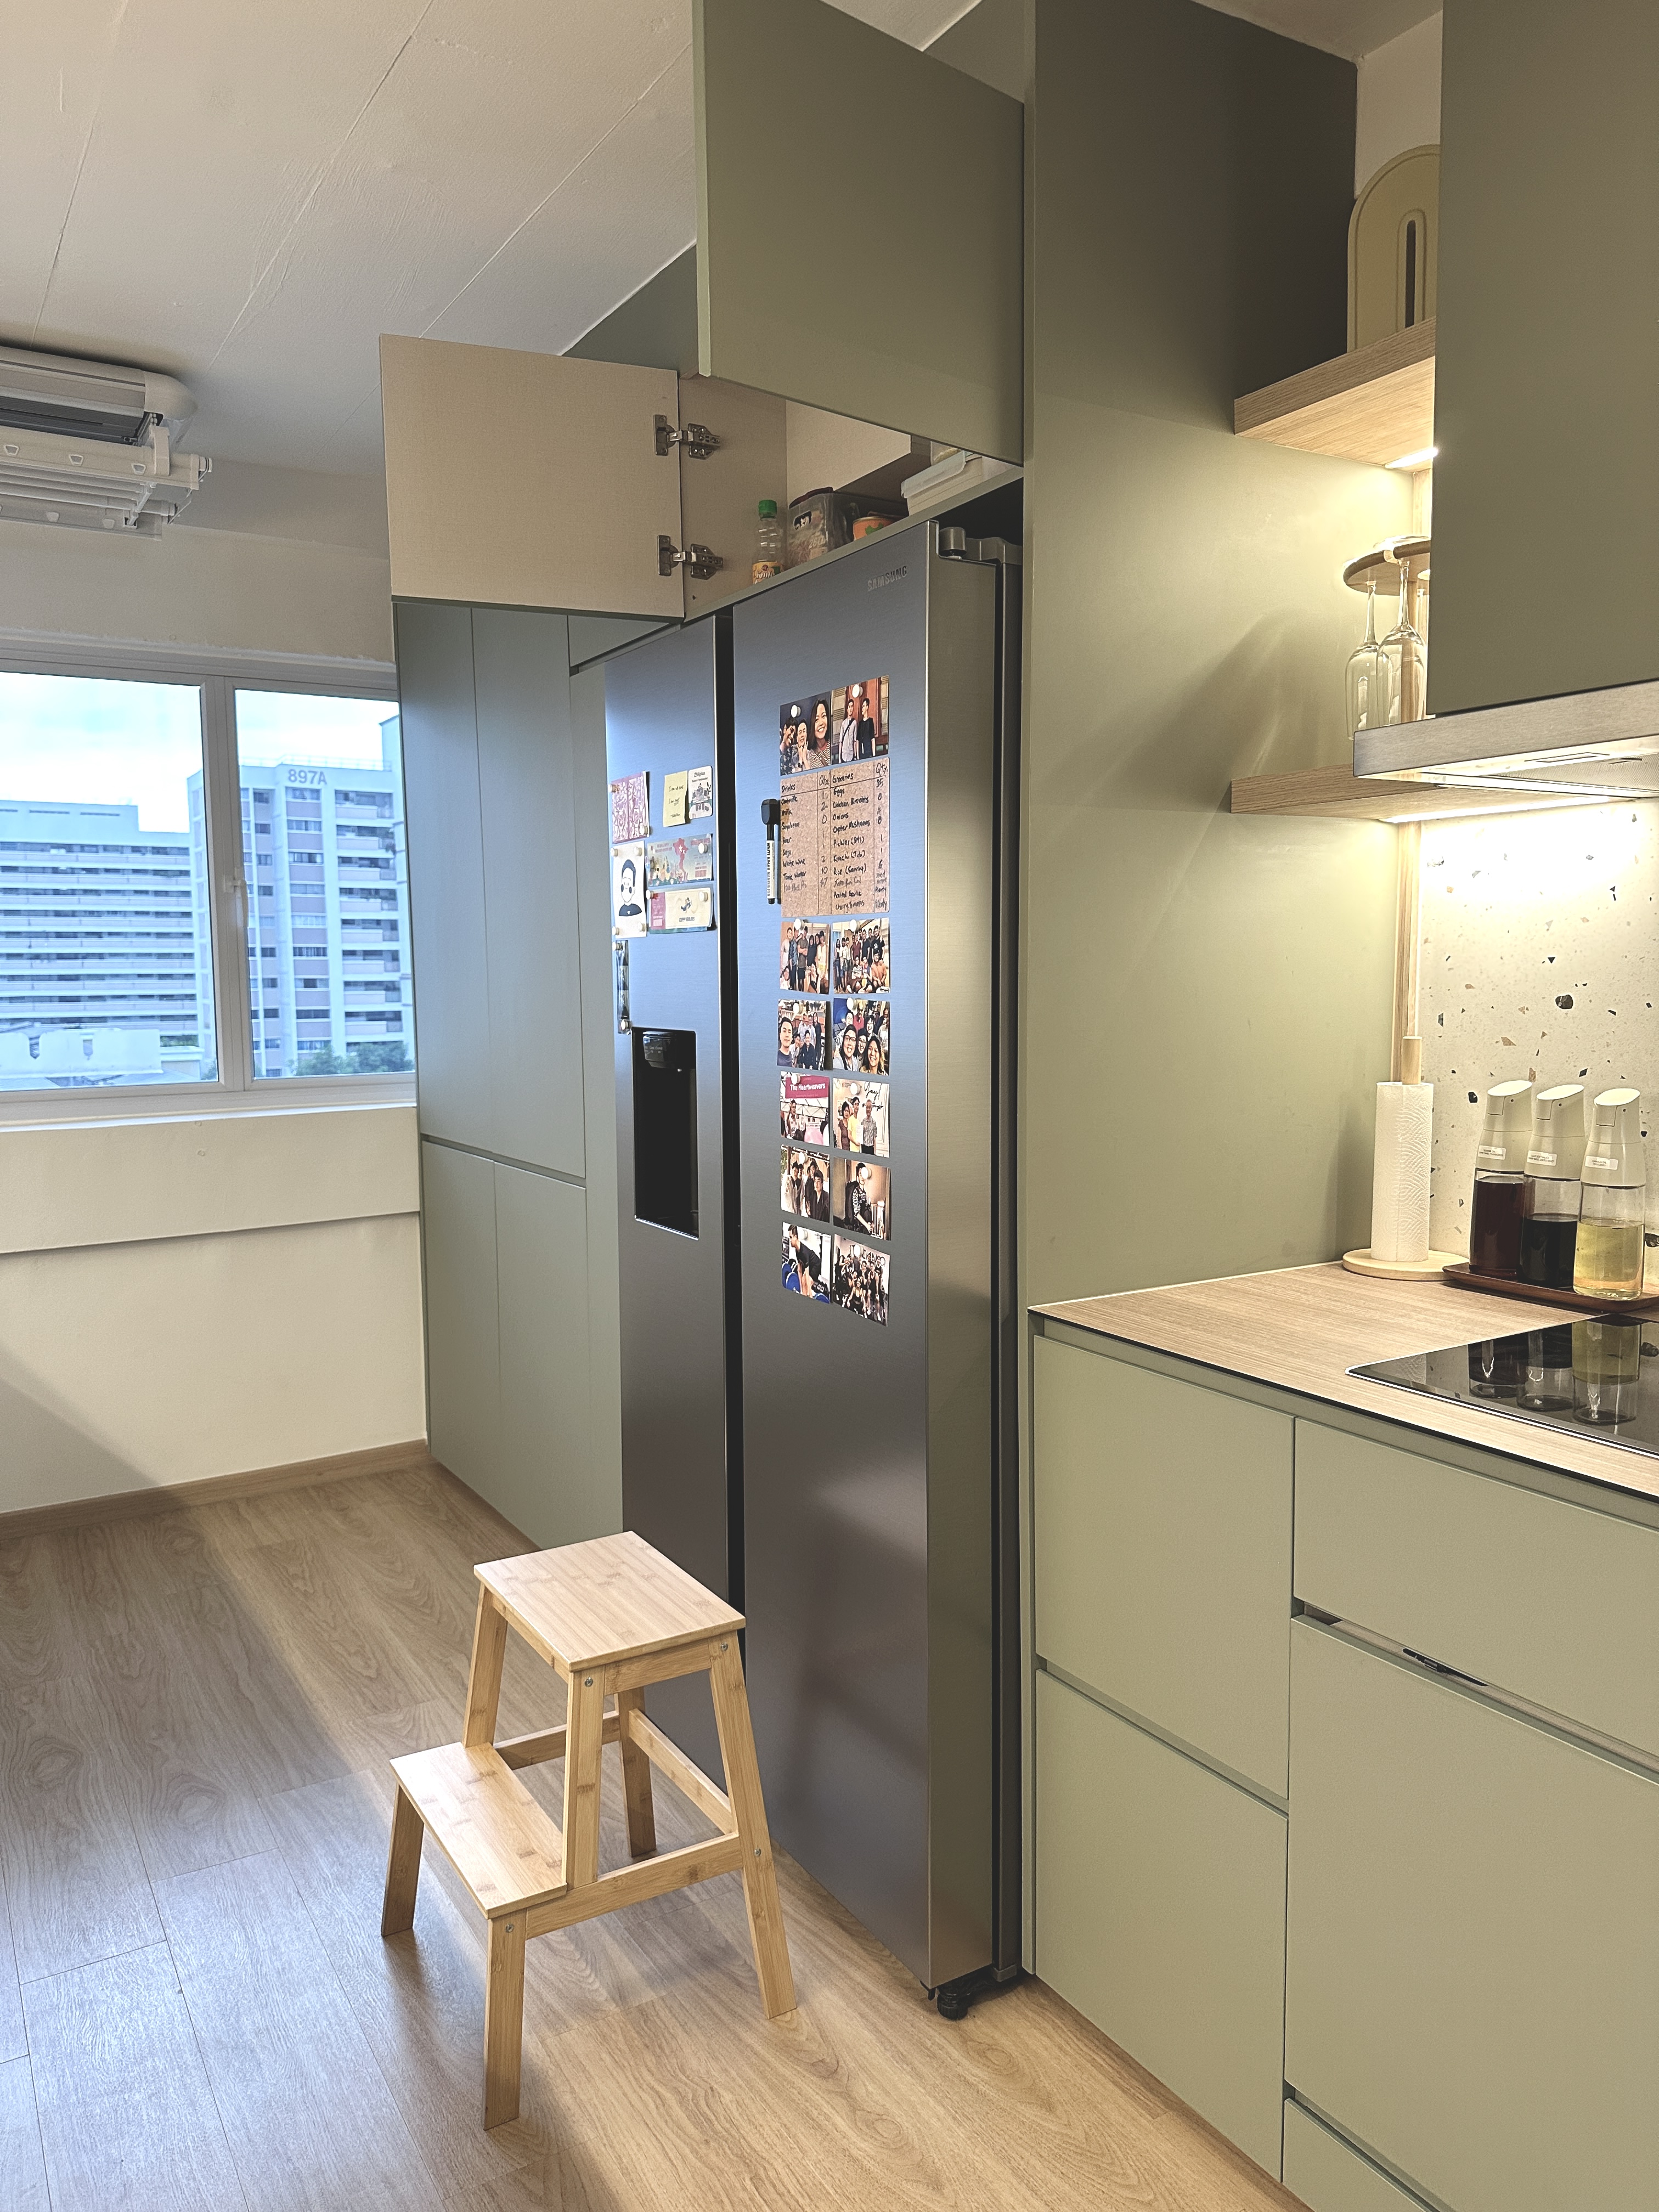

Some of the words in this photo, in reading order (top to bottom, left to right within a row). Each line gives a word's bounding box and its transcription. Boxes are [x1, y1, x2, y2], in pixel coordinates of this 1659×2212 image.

[867, 566, 907, 592] SAMSUNG
[288, 769, 328, 785] 897A
[781, 783, 795, 793] Drinks
[832, 812, 849, 820] Onions
